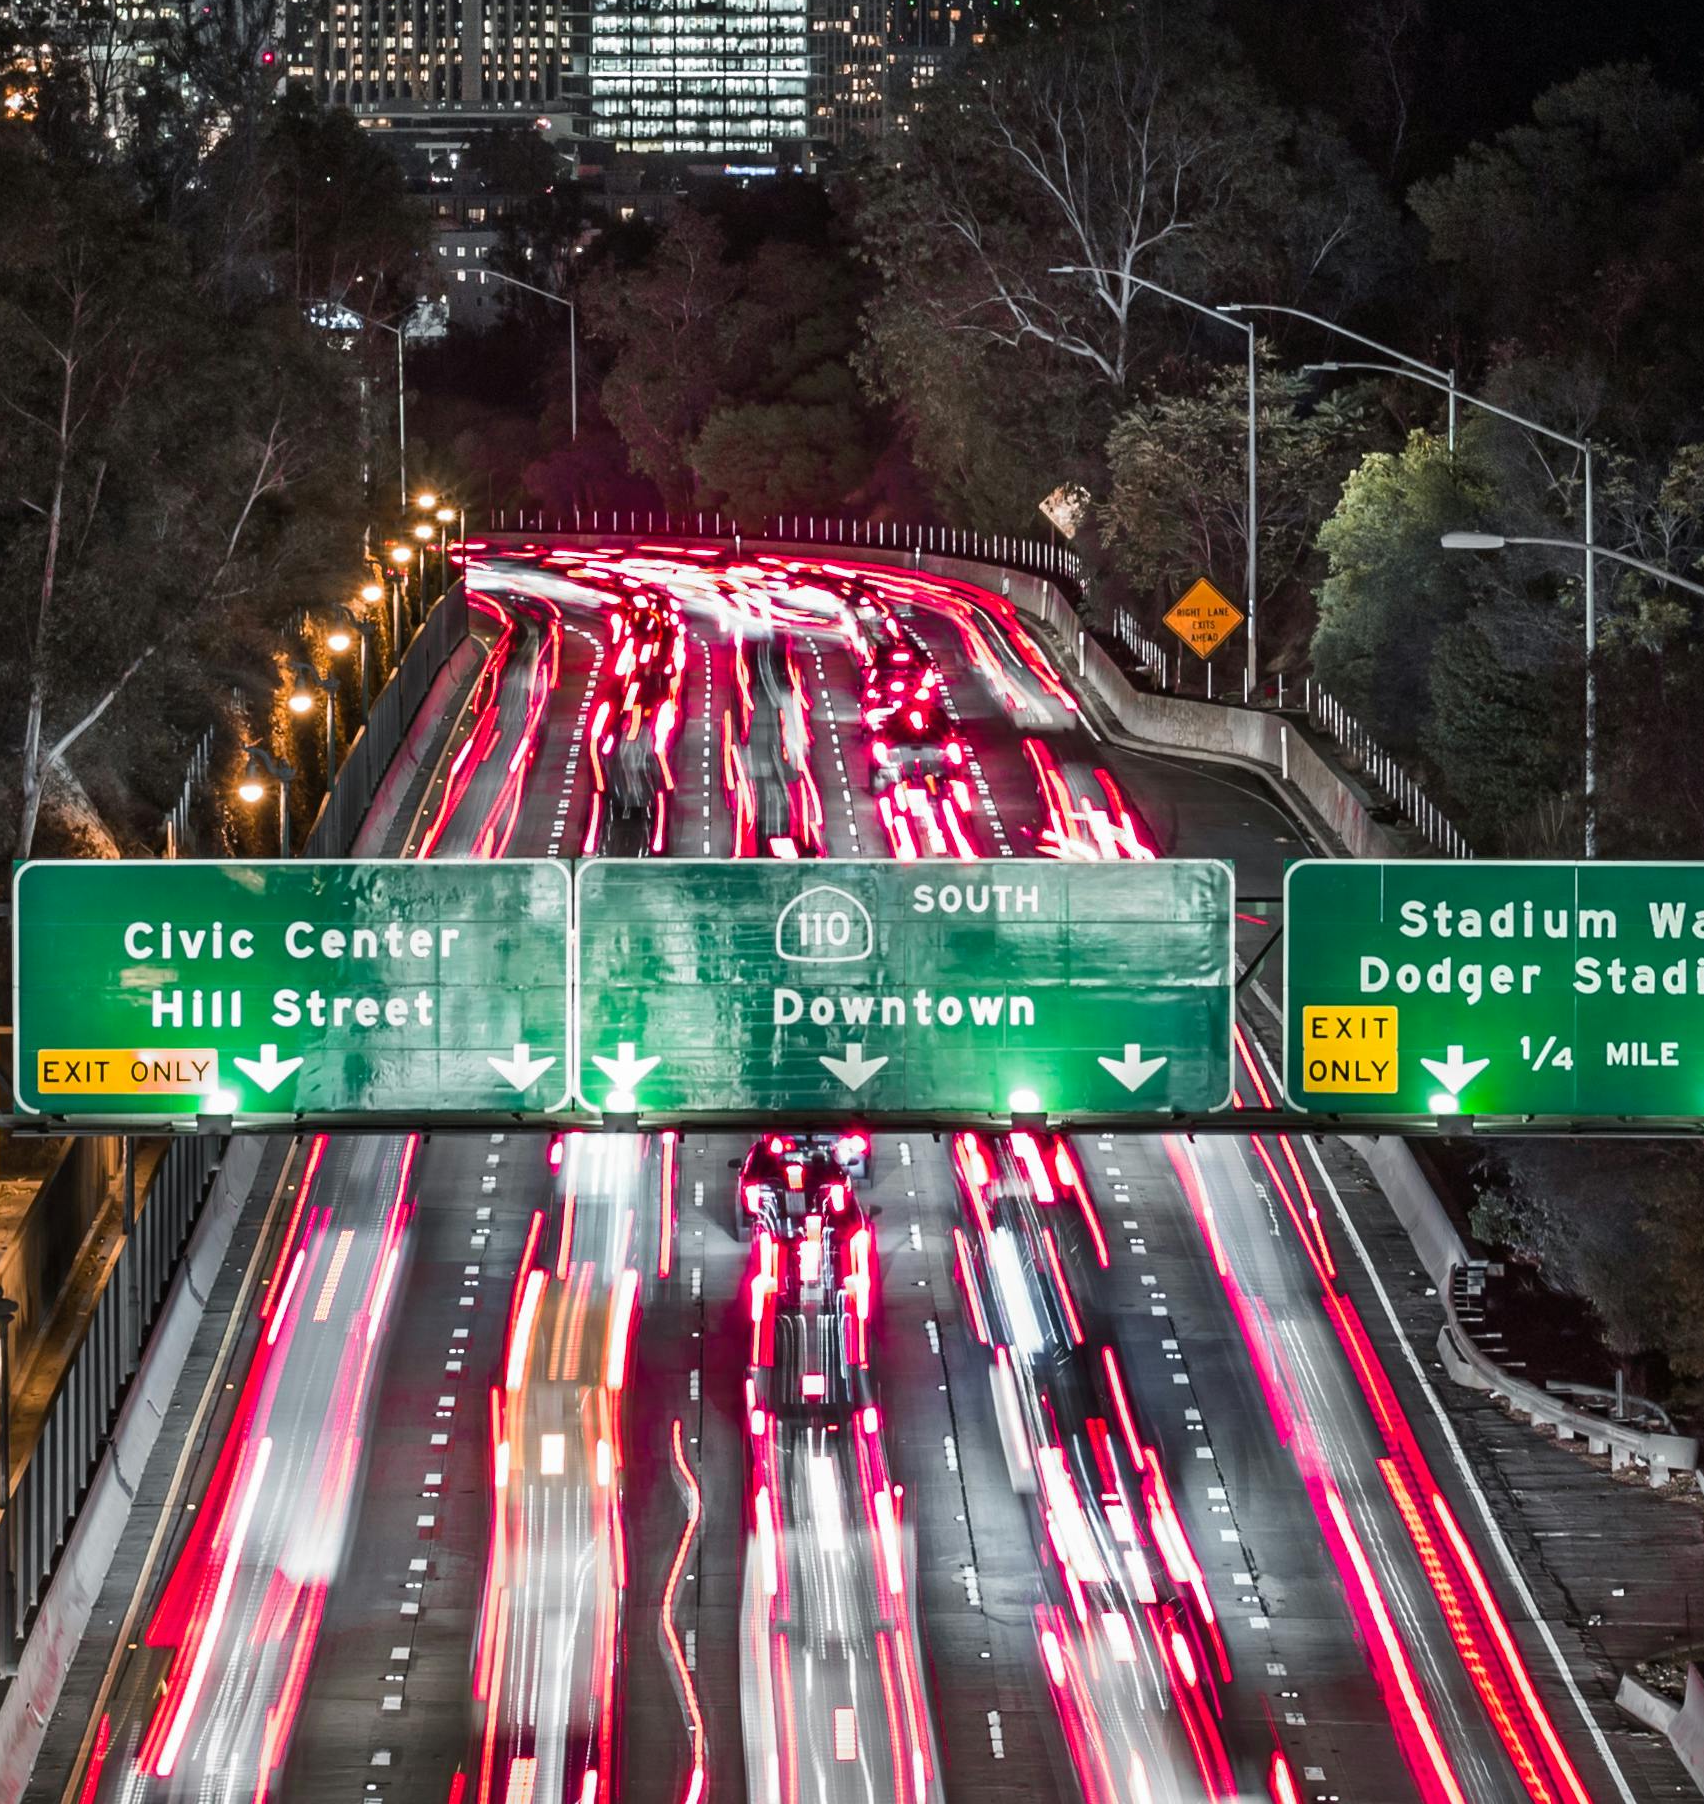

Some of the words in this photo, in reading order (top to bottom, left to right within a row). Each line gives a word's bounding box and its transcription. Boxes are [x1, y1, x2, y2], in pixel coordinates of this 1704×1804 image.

[1177, 608, 1200, 616] RIGHT
[1208, 608, 1229, 616] LANE
[1192, 620, 1215, 630] EXITS
[1191, 633, 1218, 642] AHEAD
[912, 885, 1039, 913] SOUTH
[798, 911, 850, 946] 110
[1399, 900, 1617, 940] Stadium
[124, 921, 255, 959] Civic
[284, 921, 460, 959] Center
[1360, 955, 1542, 1004] Dodger
[151, 988, 242, 1028] Hill
[271, 988, 434, 1028] Street
[773, 988, 1035, 1026] Downtown
[1312, 1017, 1389, 1040] EXIT
[1606, 1042, 1679, 1067] MILE
[43, 1060, 109, 1083] EXIT
[131, 1060, 210, 1083] ONLY
[1308, 1060, 1390, 1082] ONLY
